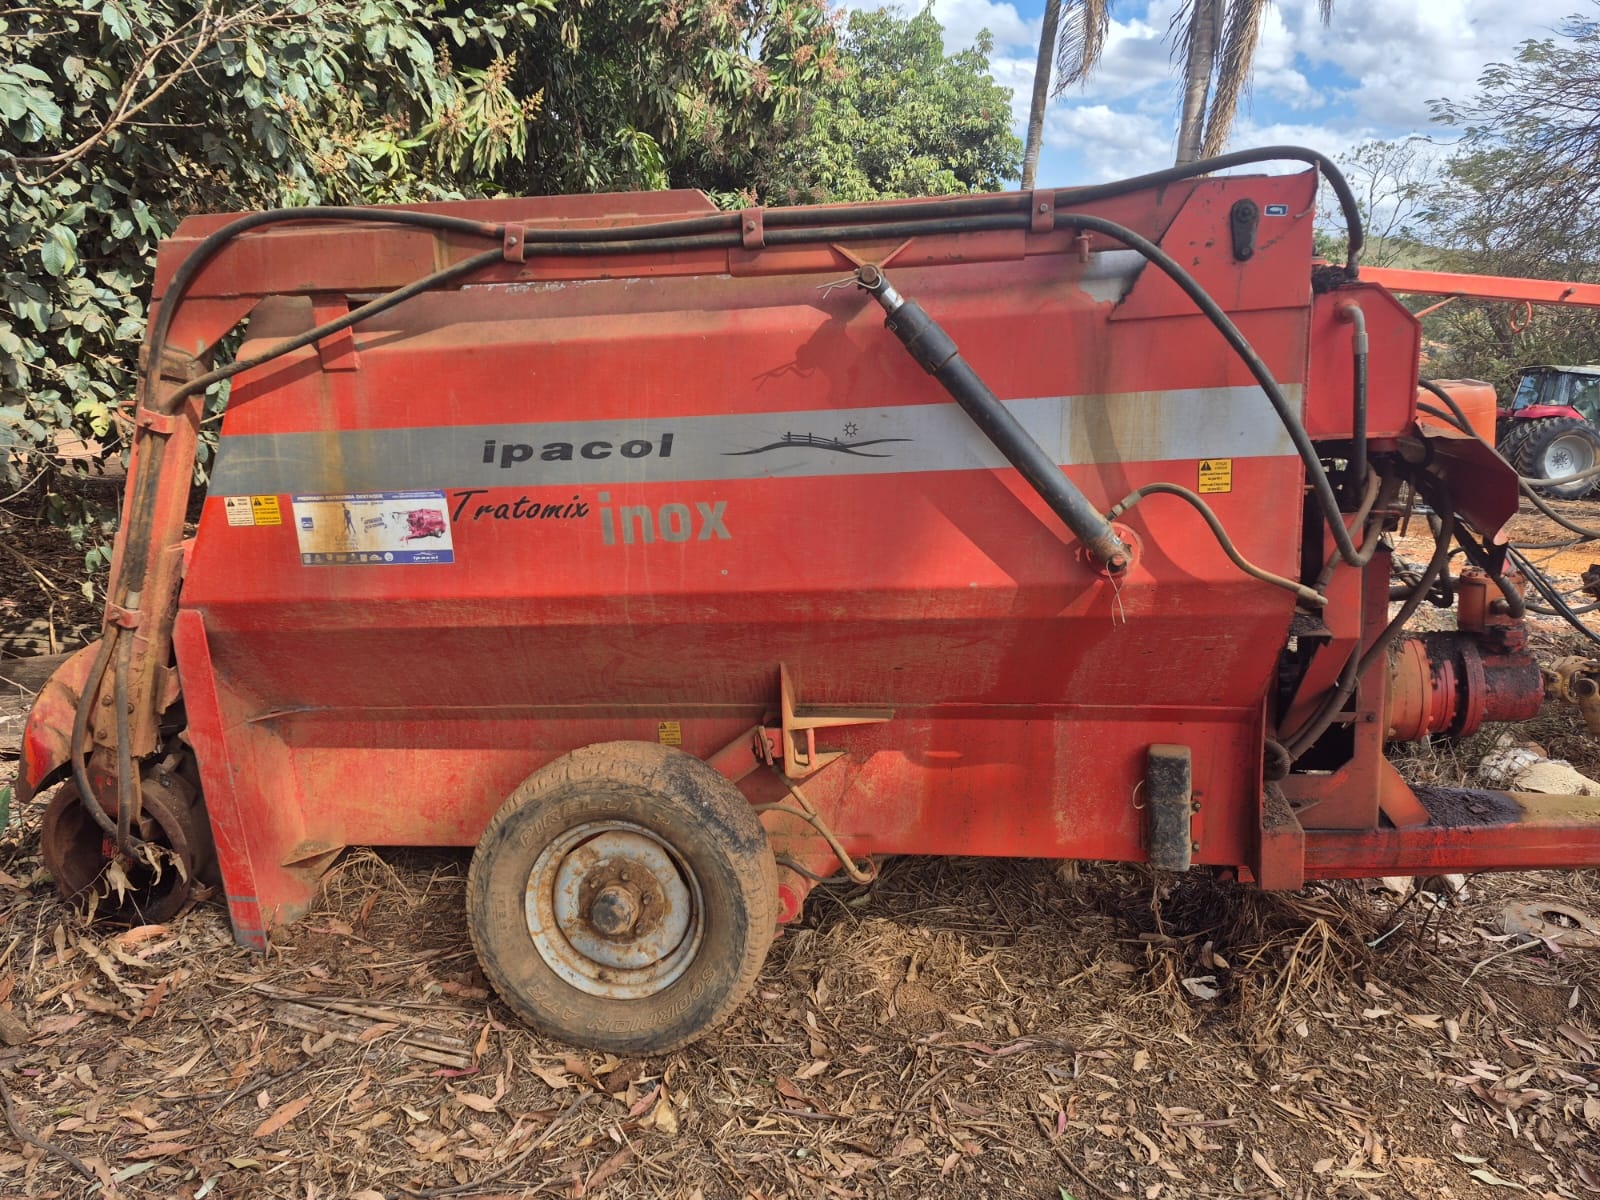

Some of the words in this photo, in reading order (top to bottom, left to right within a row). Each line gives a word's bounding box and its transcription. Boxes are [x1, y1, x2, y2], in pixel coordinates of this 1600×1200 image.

[482, 433, 674, 469] ipacol
[453, 489, 590, 522] Tratomix
[598, 491, 732, 546] inox
[520, 799, 632, 848] PIRELLI
[587, 967, 716, 1032] SCORPION
